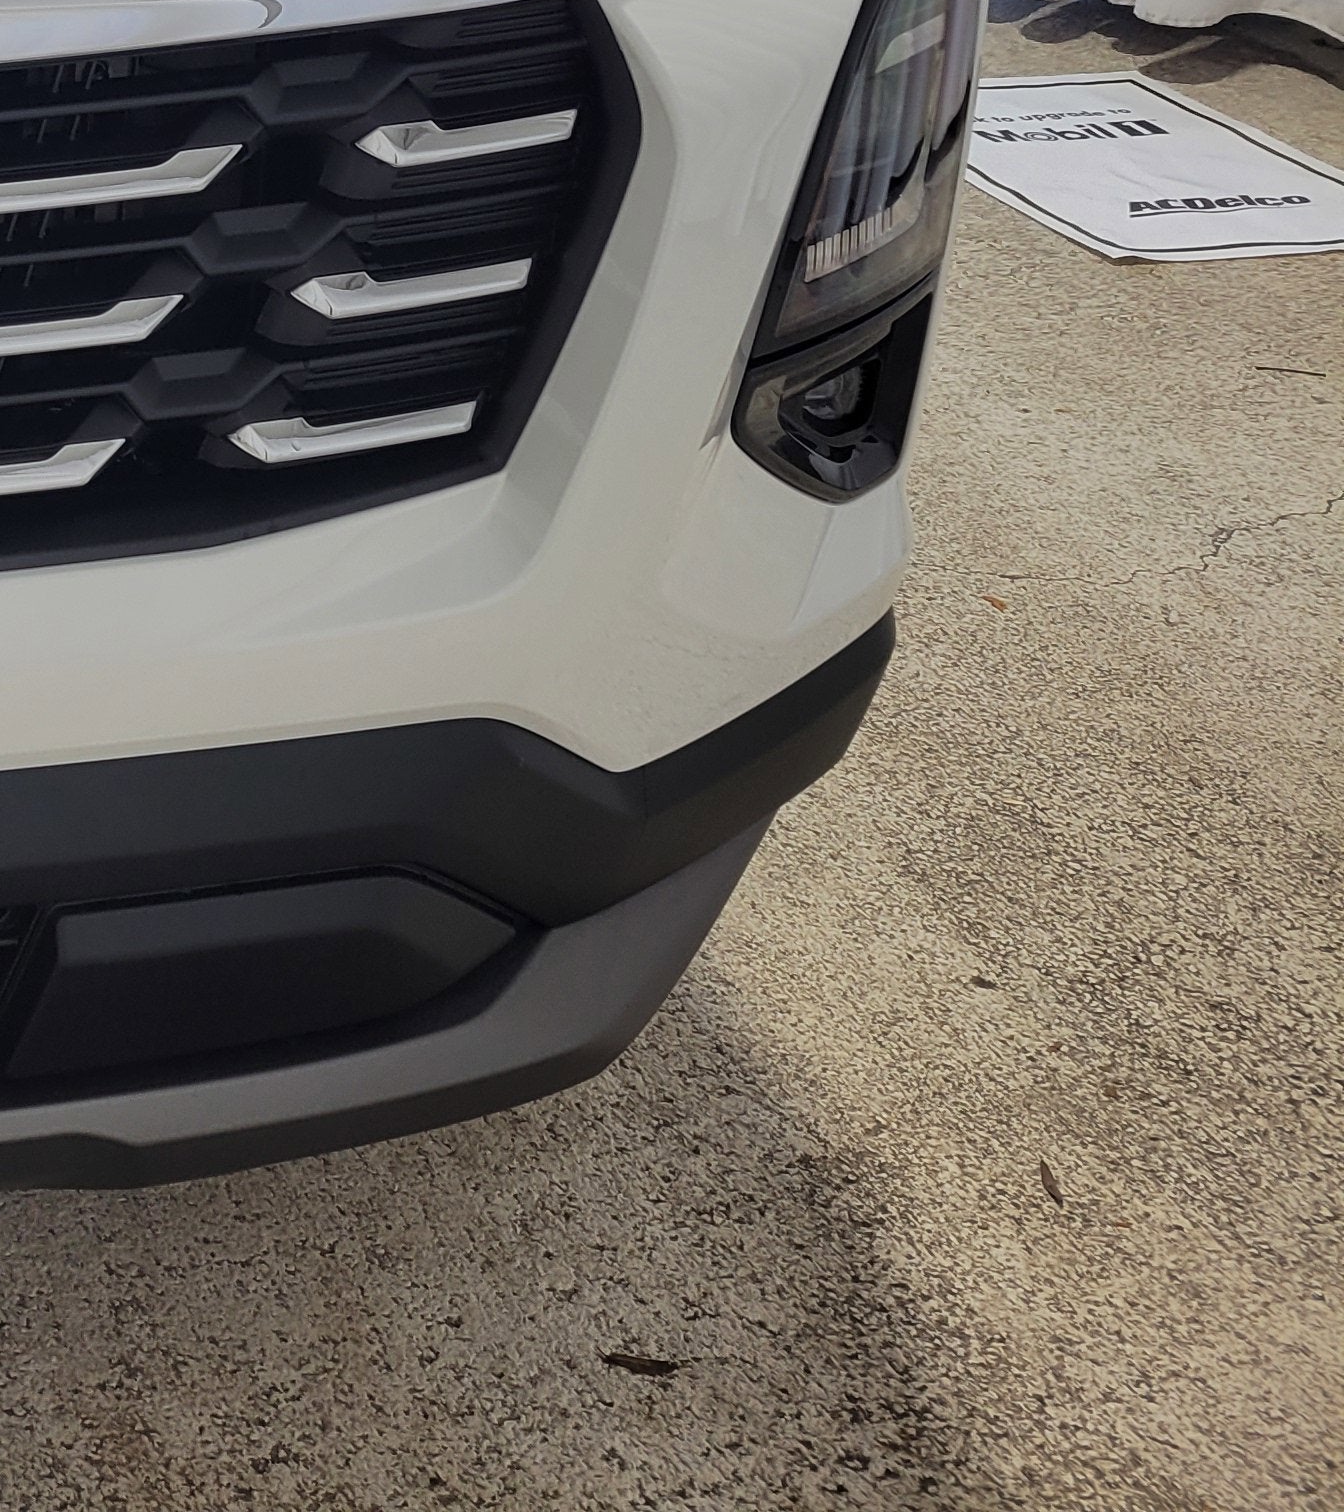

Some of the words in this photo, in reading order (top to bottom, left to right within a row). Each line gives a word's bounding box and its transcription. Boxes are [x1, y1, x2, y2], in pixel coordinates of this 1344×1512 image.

[1018, 110, 1105, 122] upgrade
[972, 123, 1119, 143] Mobil
[1129, 194, 1311, 213] ACDelco
